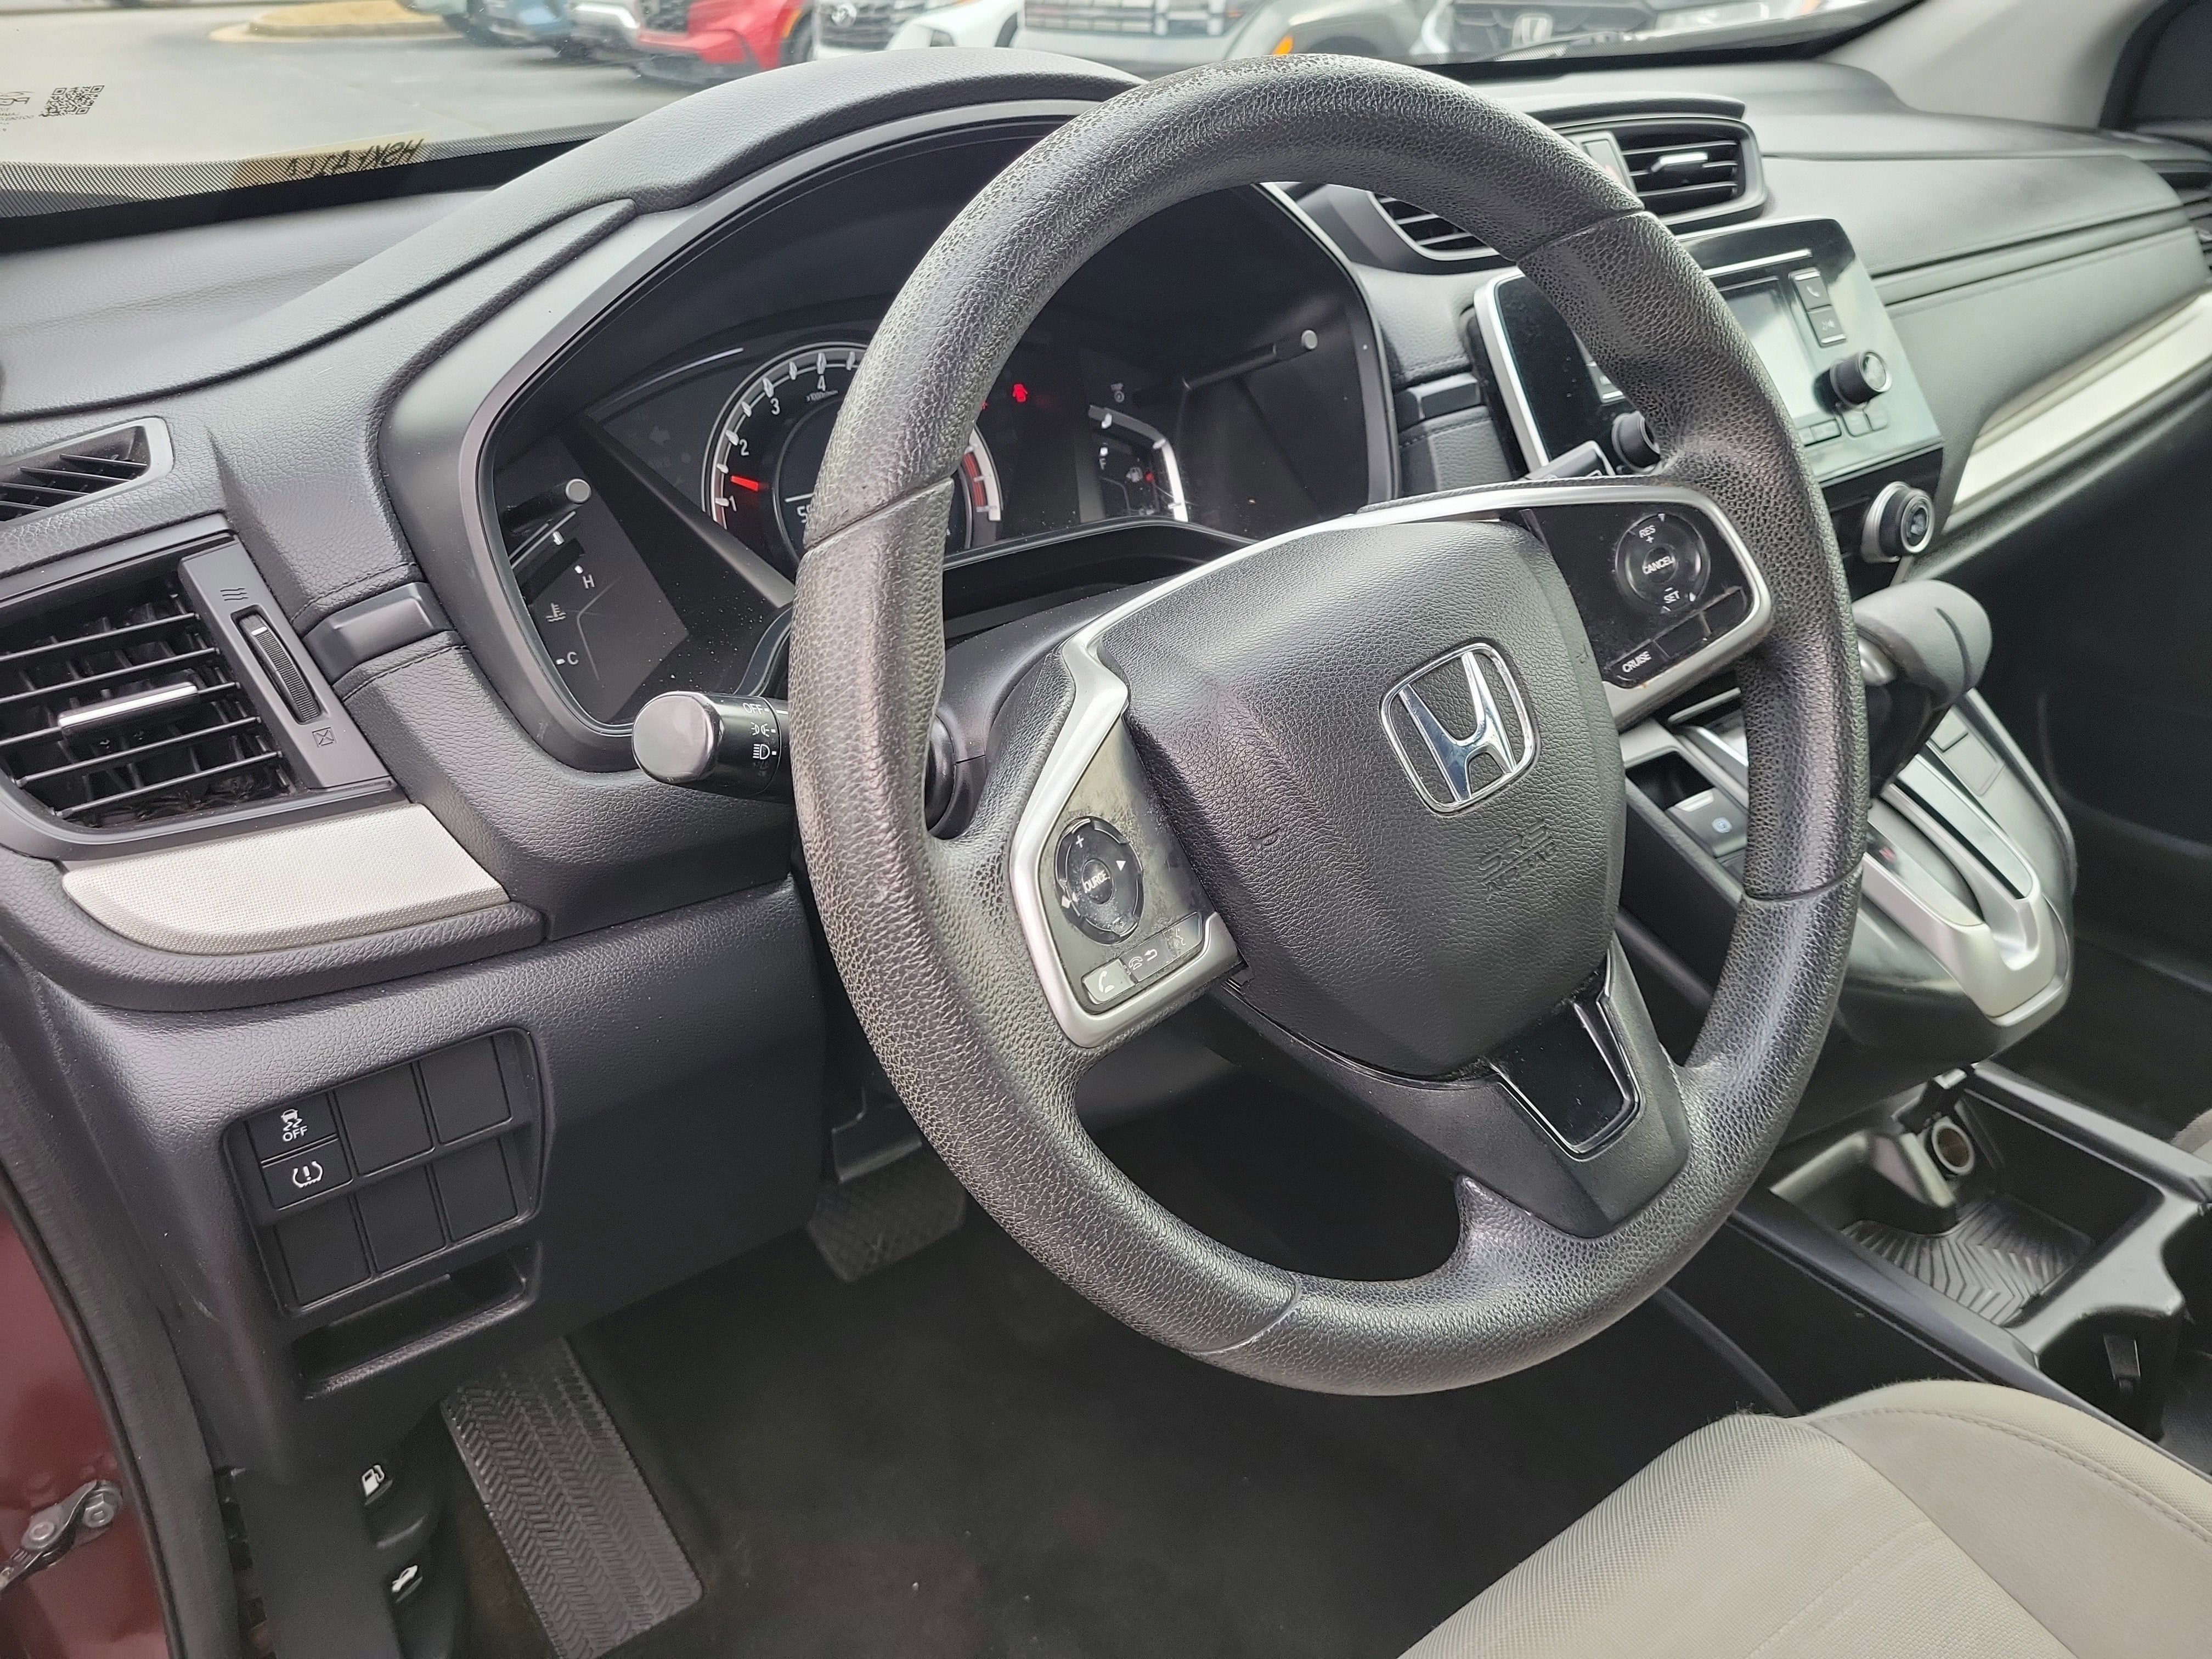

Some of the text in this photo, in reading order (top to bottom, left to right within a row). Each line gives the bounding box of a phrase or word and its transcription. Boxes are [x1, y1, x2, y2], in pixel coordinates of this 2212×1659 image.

[816, 374, 826, 392] 4
[770, 398, 780, 415] 3
[738, 439, 749, 456] 2
[729, 495, 737, 512] 1
[1639, 524, 1656, 538] RES
[1642, 556, 1674, 574] CANCEL
[582, 575, 595, 589] H
[1664, 590, 1680, 603] SET
[567, 652, 579, 665] C
[1622, 651, 1652, 673] CRUISE
[743, 703, 763, 714] OFF
[1084, 870, 1108, 893] OURCE
[283, 1126, 308, 1142] OFF
